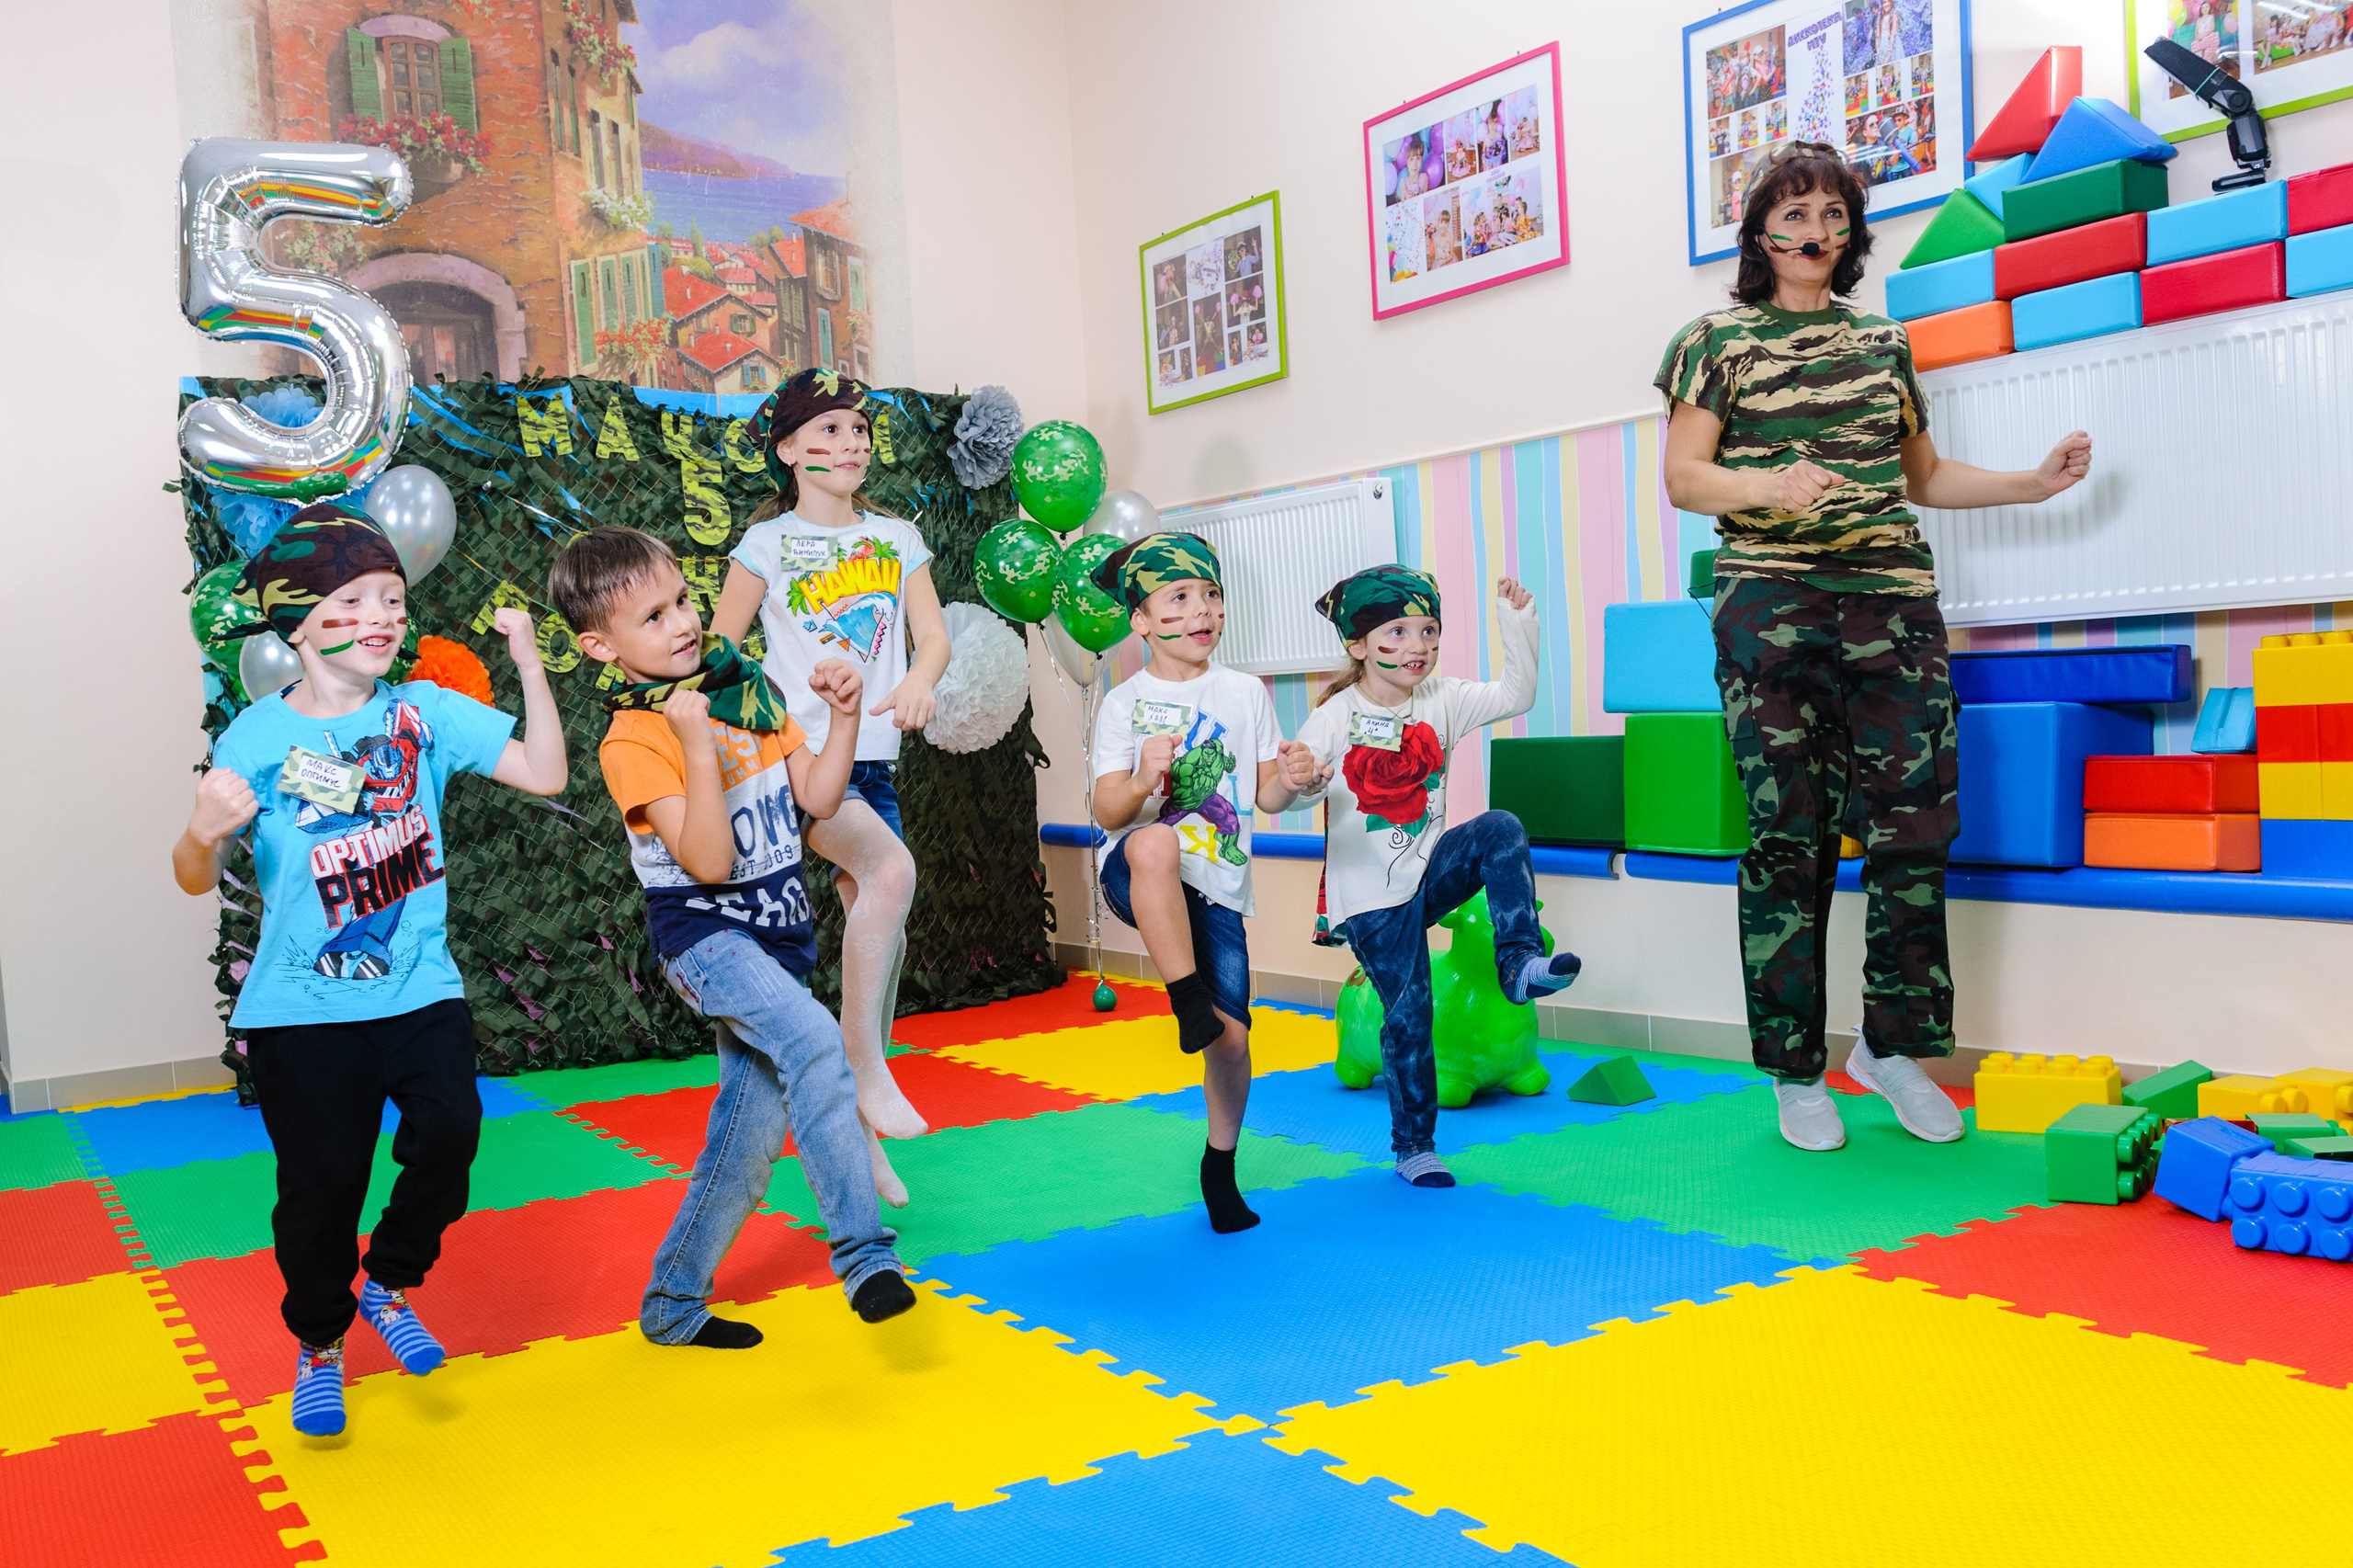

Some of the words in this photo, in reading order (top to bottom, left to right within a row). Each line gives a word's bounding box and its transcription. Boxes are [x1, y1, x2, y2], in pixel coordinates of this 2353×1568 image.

[1788, 11, 1842, 48] ДИСКОТЕКА
[175, 136, 414, 507] 5
[680, 459, 732, 546] 5
[796, 540, 816, 548] ЛЕРА
[798, 558, 901, 615] HAWAII
[301, 768, 341, 789] ОПТИМУС
[306, 758, 337, 776] МАКС
[309, 803, 429, 879] OPTIMUS
[315, 831, 446, 929] PRIME
